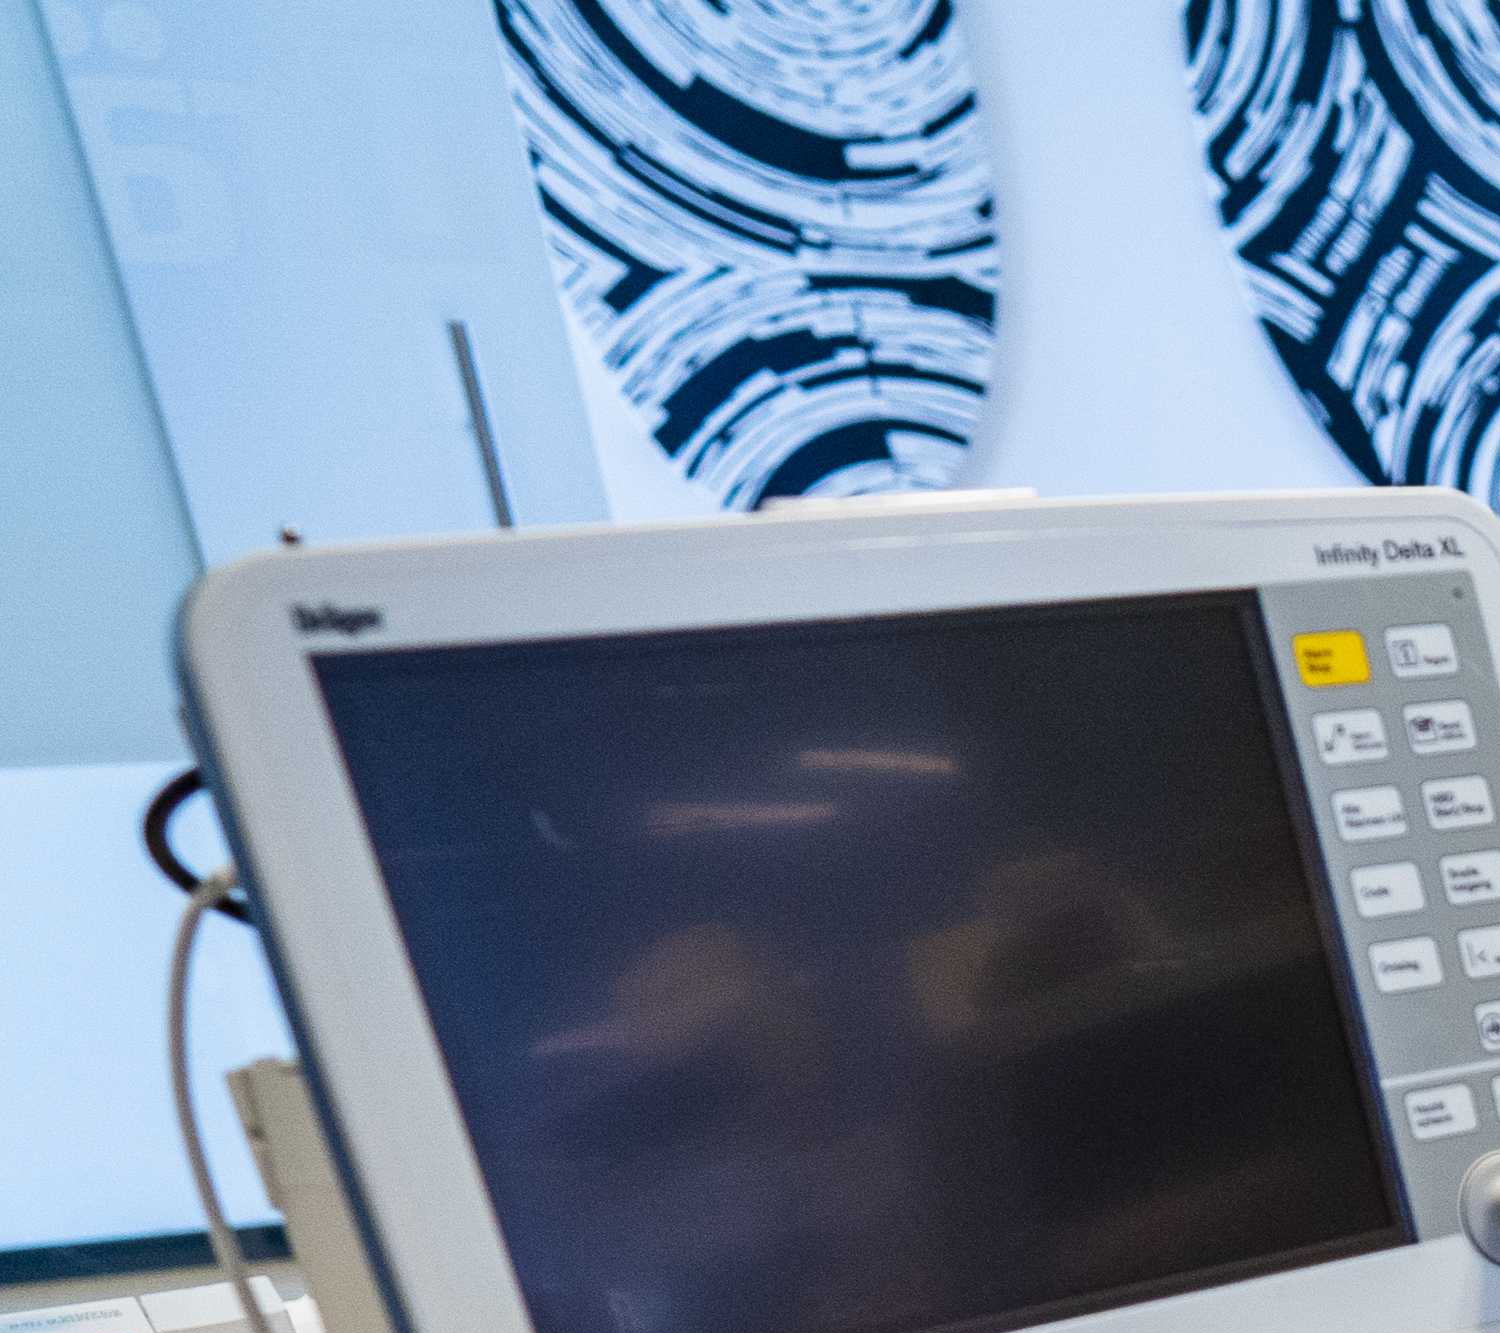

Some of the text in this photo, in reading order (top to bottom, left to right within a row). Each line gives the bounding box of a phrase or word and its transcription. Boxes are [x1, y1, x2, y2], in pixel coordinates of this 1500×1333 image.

[1313, 537, 1465, 567] Infinity Delta XL
